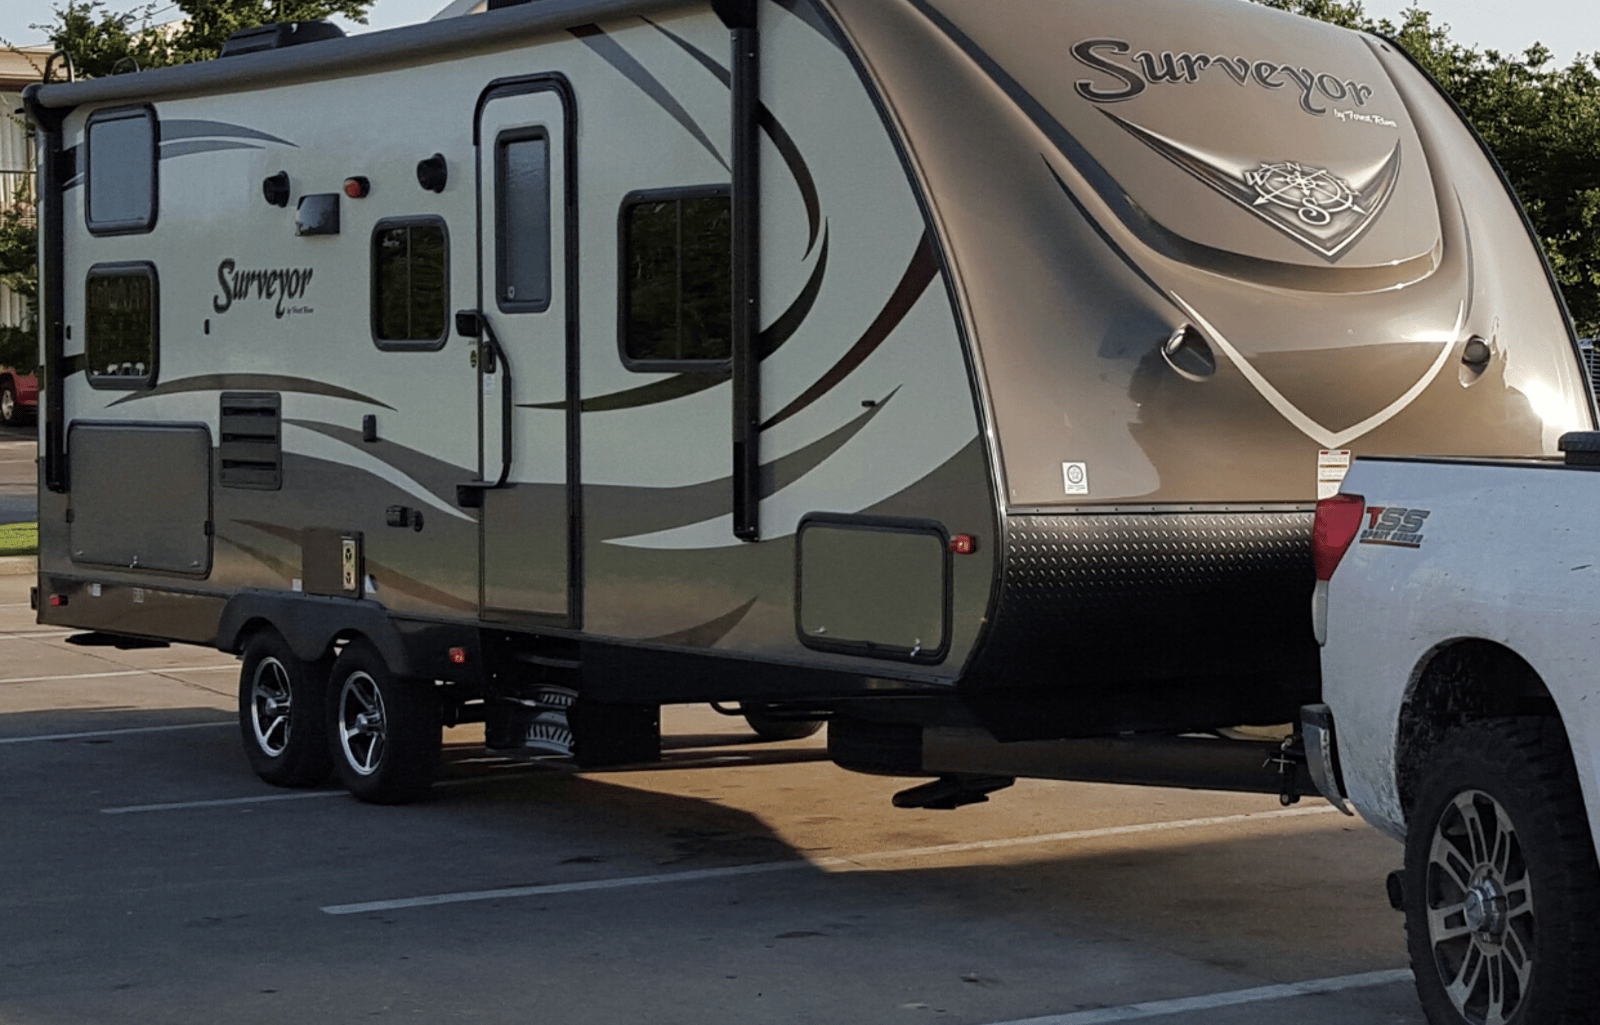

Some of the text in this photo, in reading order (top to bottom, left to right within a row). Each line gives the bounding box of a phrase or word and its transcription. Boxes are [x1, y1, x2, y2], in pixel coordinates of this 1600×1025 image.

[1069, 38, 1374, 116] Surveyor
[1298, 197, 1331, 226] S
[213, 257, 314, 319] Surveyor
[1366, 506, 1431, 533] TSS
